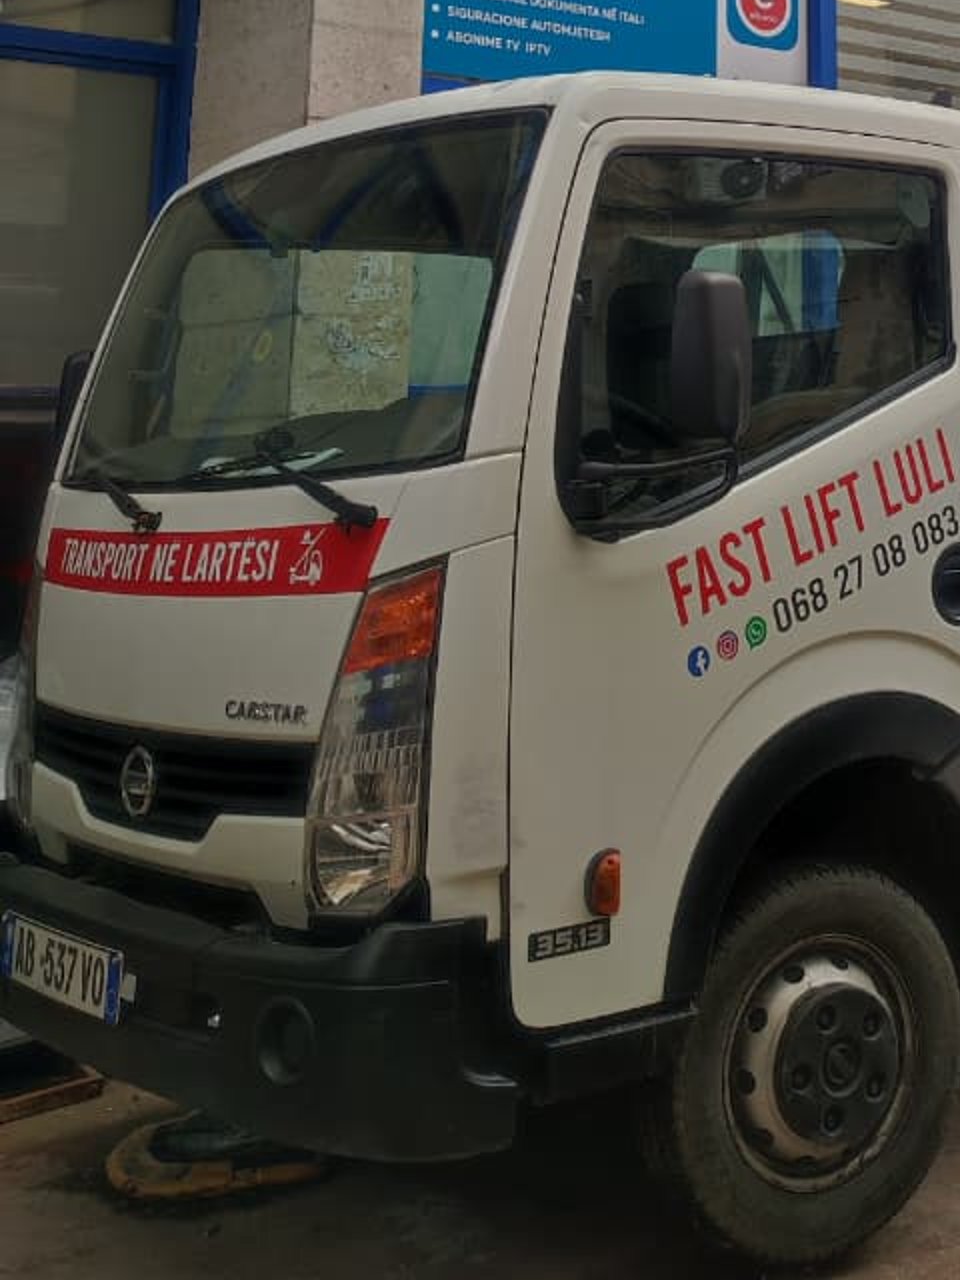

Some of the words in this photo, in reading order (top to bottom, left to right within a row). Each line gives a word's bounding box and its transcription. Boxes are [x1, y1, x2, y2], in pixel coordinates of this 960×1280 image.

[447, 5, 529, 29] SIGURACIONE
[619, 11, 645, 25] ITALI
[446, 30, 503, 50] ABONIME
[506, 38, 521, 52] TV
[525, 41, 552, 57] IPTV
[666, 517, 772, 626] FAST
[781, 471, 865, 566] LIFT
[873, 428, 955, 517] LULI
[62, 538, 149, 582] TRANSPORT
[181, 537, 281, 583] LARTËSI
[771, 574, 828, 634] 068
[833, 554, 866, 601] 27
[871, 535, 907, 578] 08
[911, 504, 960, 555] 083
[16, 926, 35, 977] AB
[44, 937, 79, 995] 537
